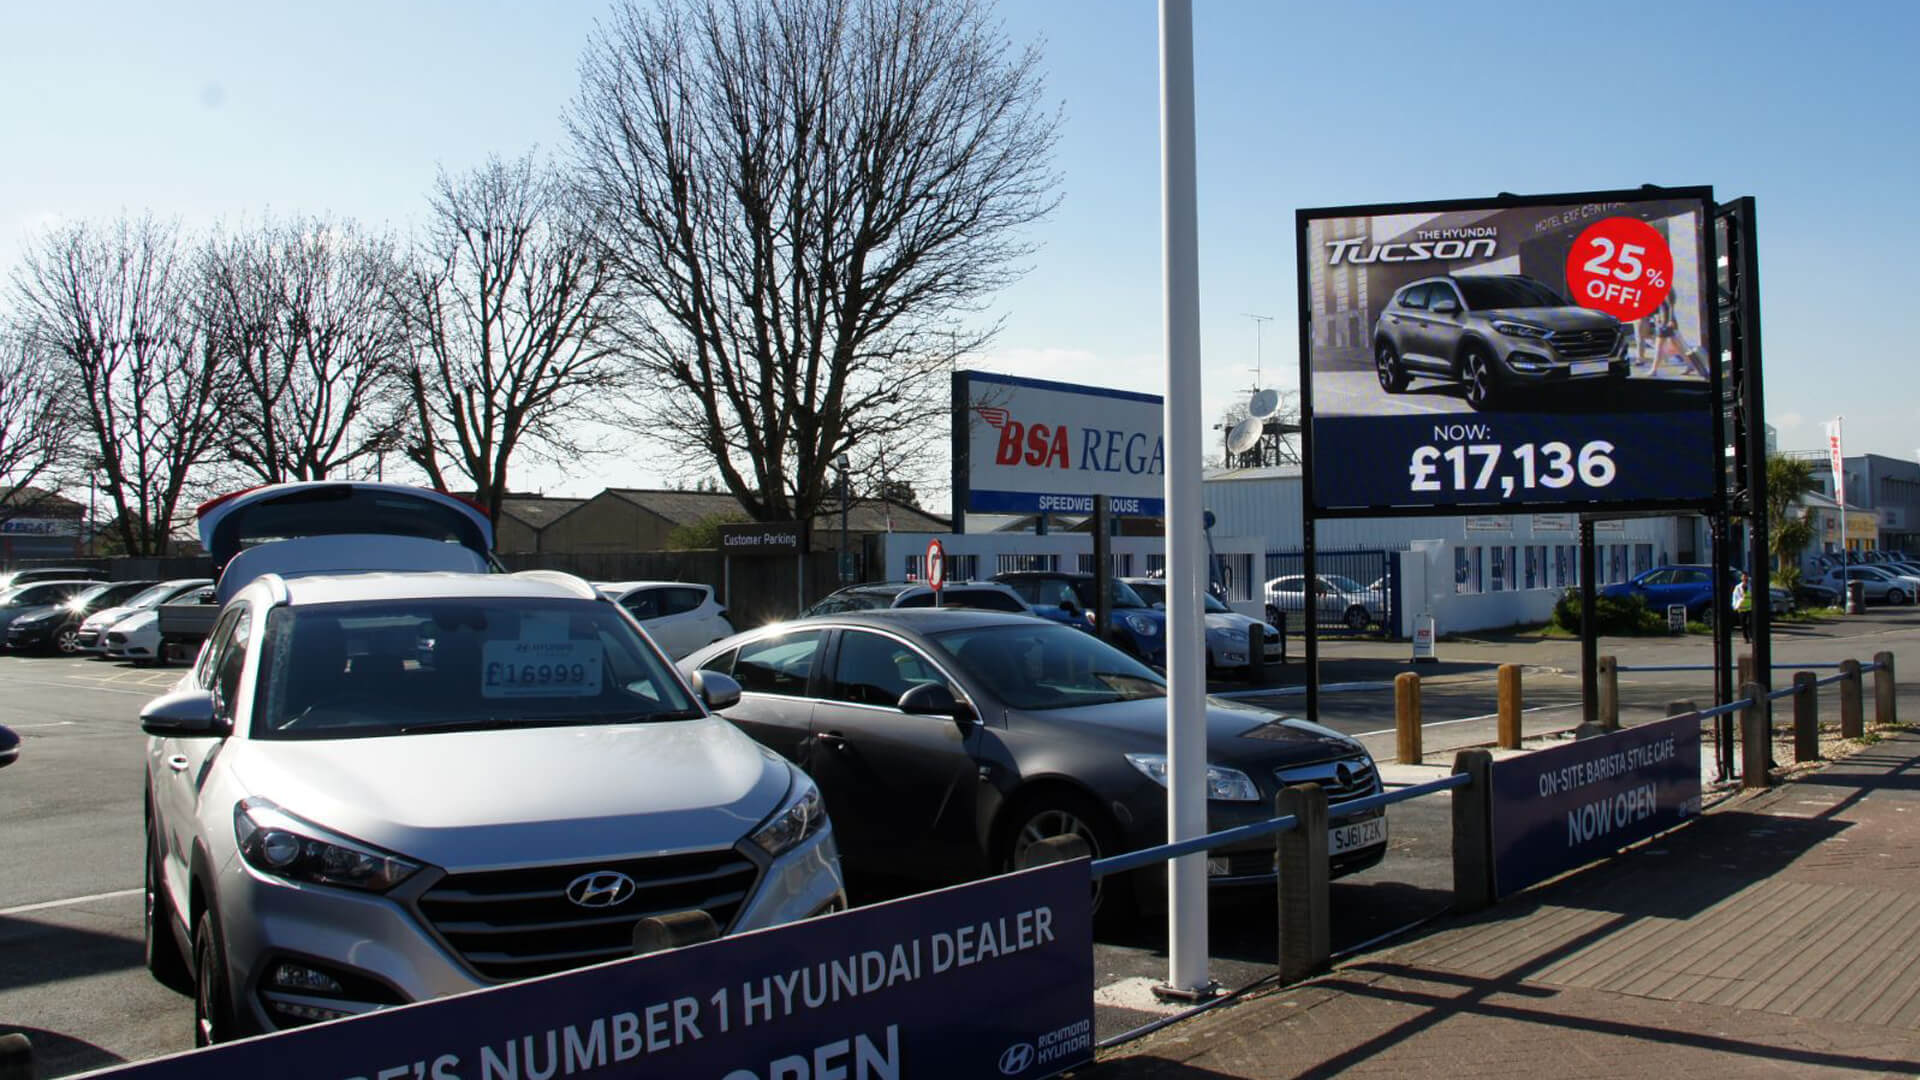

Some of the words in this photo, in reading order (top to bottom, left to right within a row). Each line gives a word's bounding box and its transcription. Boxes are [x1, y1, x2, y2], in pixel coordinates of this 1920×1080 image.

[1417, 230, 1440, 240] THE
[1442, 227, 1497, 240] HYUNDAI
[1587, 280, 1641, 308] OFF!
[995, 421, 1070, 469] BSA
[1434, 424, 1491, 441] NOW:
[1409, 440, 1616, 498] £17,136
[723, 534, 762, 546] Customer
[763, 533, 797, 547] Parking
[486, 661, 584, 687] £16999
[1539, 764, 1585, 797] ON-SITE
[1586, 754, 1626, 784] BARISTA
[1627, 743, 1653, 772] STYLE
[1568, 798, 1613, 847] NOW
[1614, 782, 1657, 829] OPEN
[1334, 826, 1361, 849] SJ61
[480, 996, 704, 1080] NUMBER
[710, 988, 729, 1033] 1
[743, 939, 921, 1027] HYUNDAI
[931, 906, 1055, 975] DEALER
[1038, 1018, 1090, 1048] RICHMOND
[721, 1024, 900, 1080] EN
[1038, 1033, 1090, 1064] HYUNDAI
